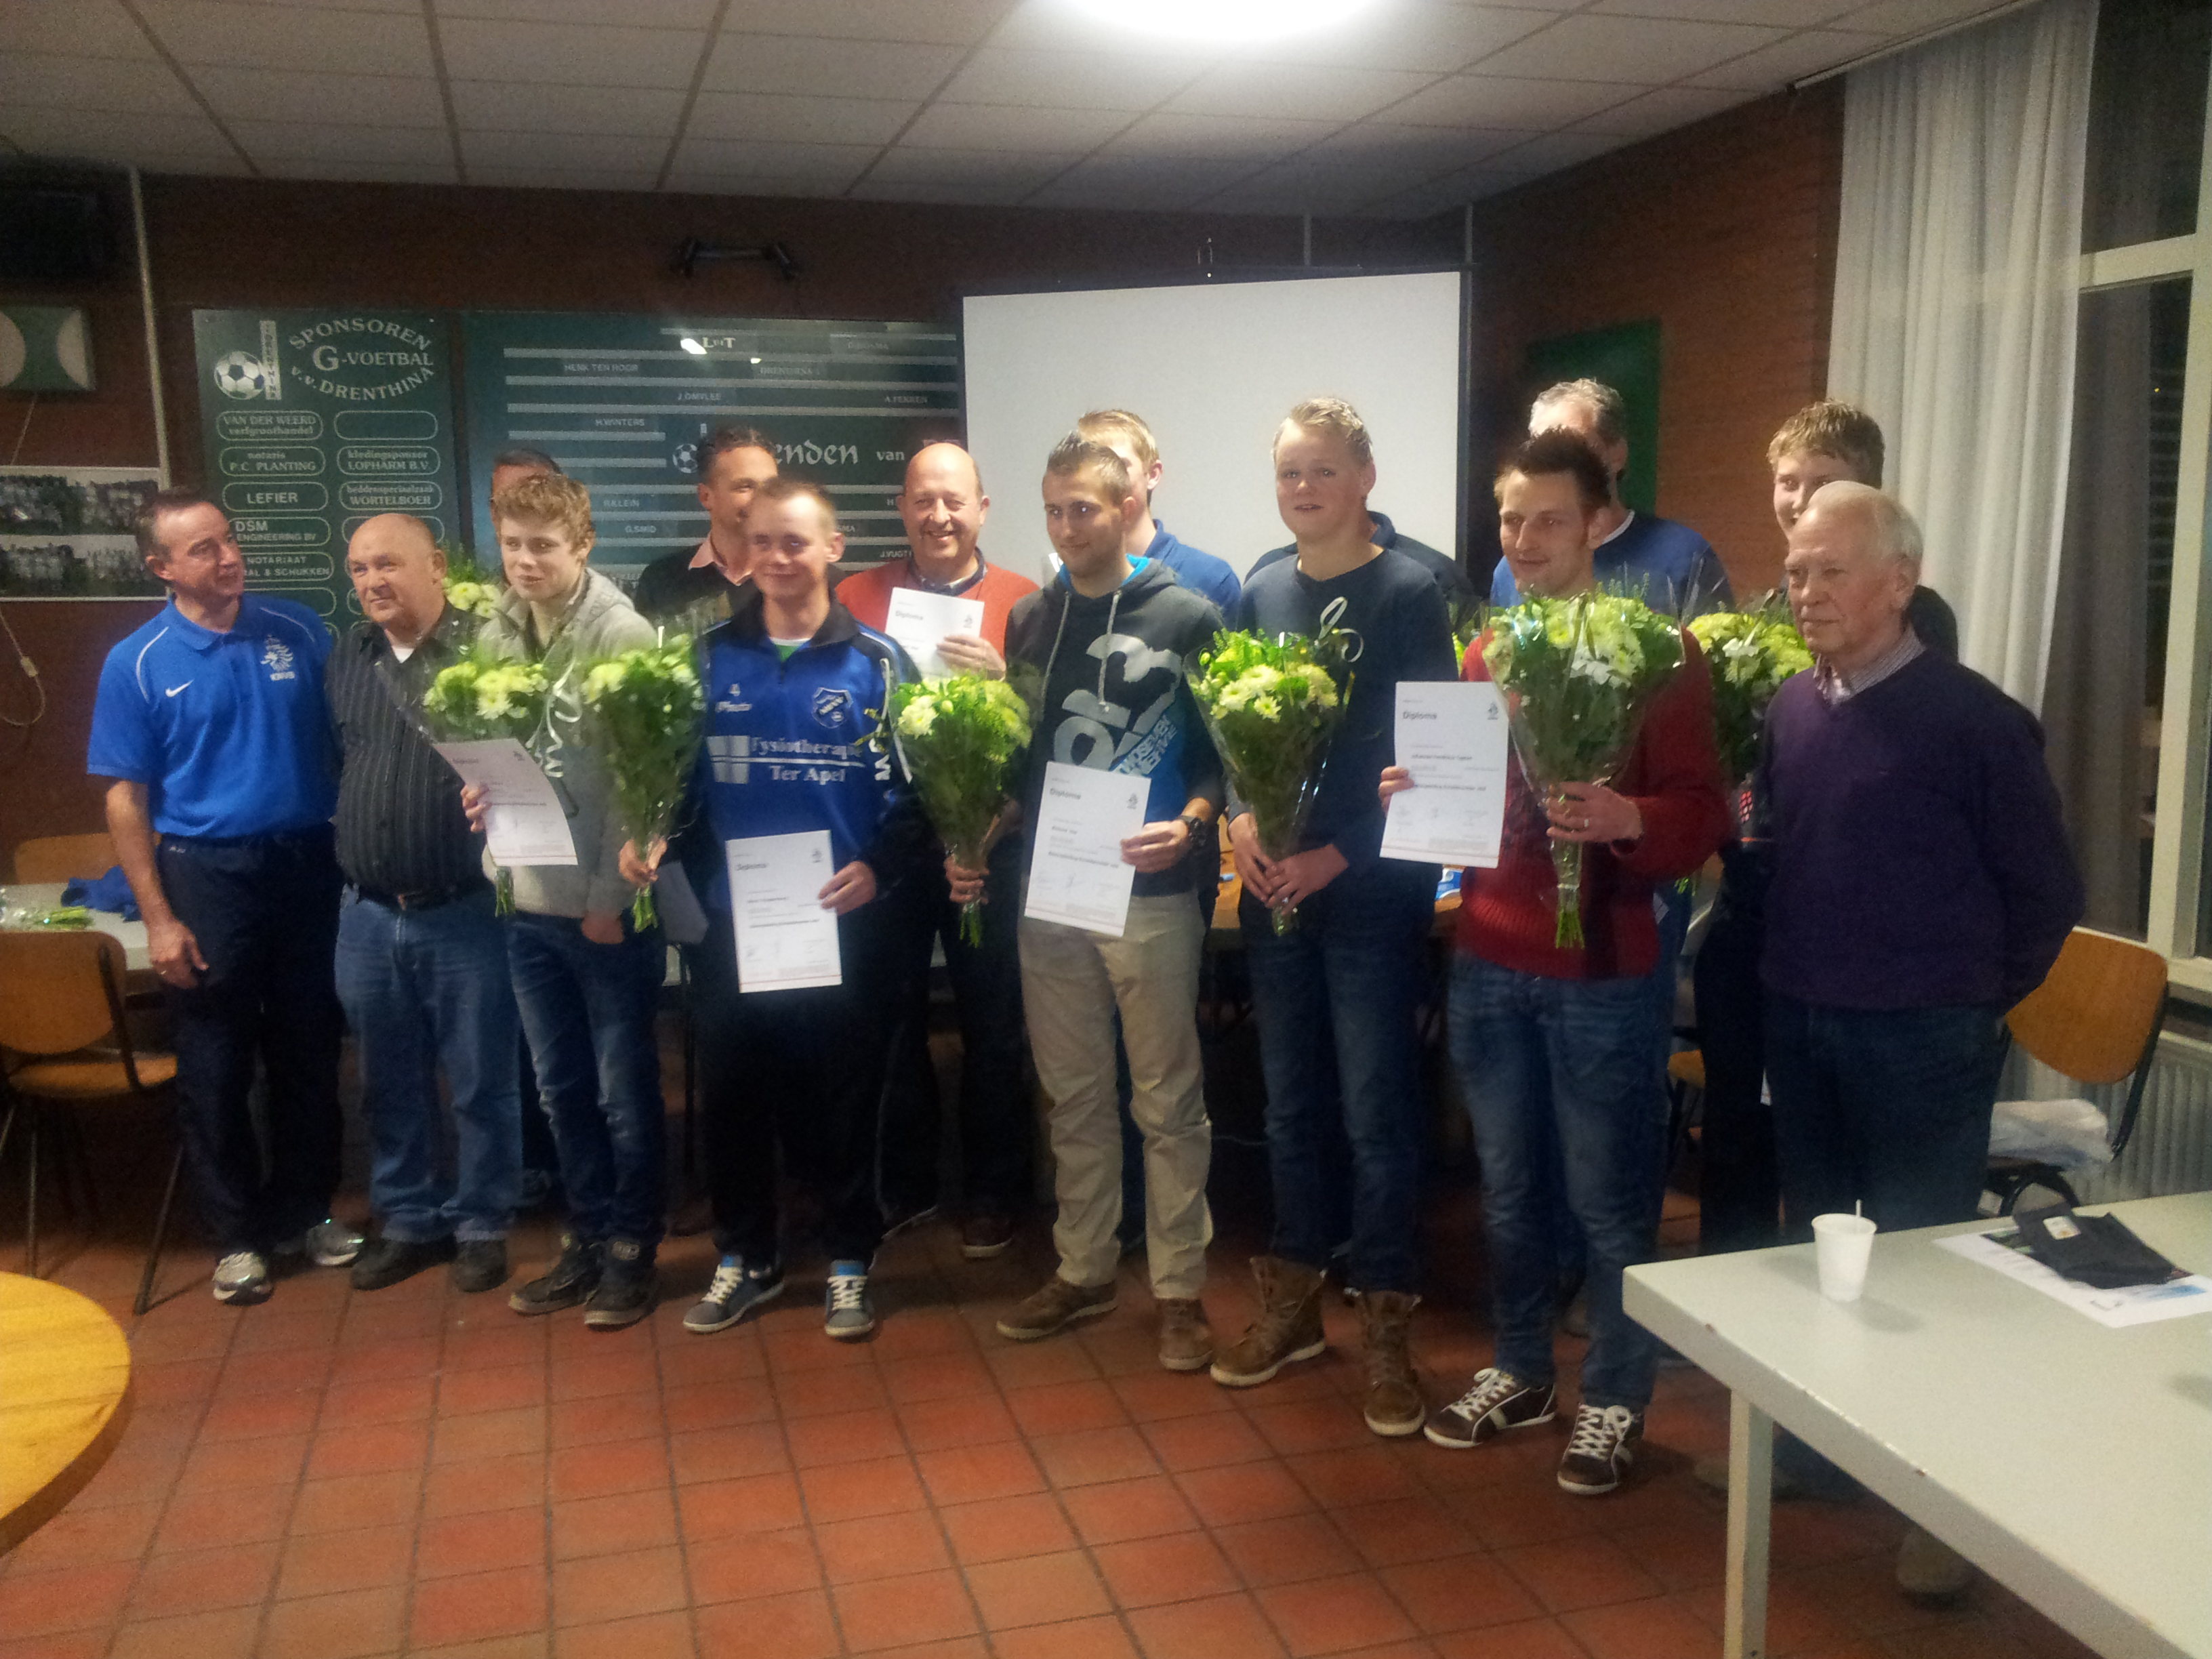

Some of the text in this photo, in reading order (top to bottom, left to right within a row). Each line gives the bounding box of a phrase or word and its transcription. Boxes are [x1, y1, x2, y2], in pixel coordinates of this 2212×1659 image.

[289, 318, 432, 350] SPONSOREN
[319, 367, 434, 401] DRENTHINA
[224, 415, 316, 425] VAN DER WEERD
[876, 450, 905, 461] van
[256, 462, 316, 471] PLANTING
[247, 492, 298, 504] LEFIER
[235, 520, 268, 532] DSM
[1402, 711, 1437, 720] Diploma
[769, 766, 846, 785] Ter Apel
